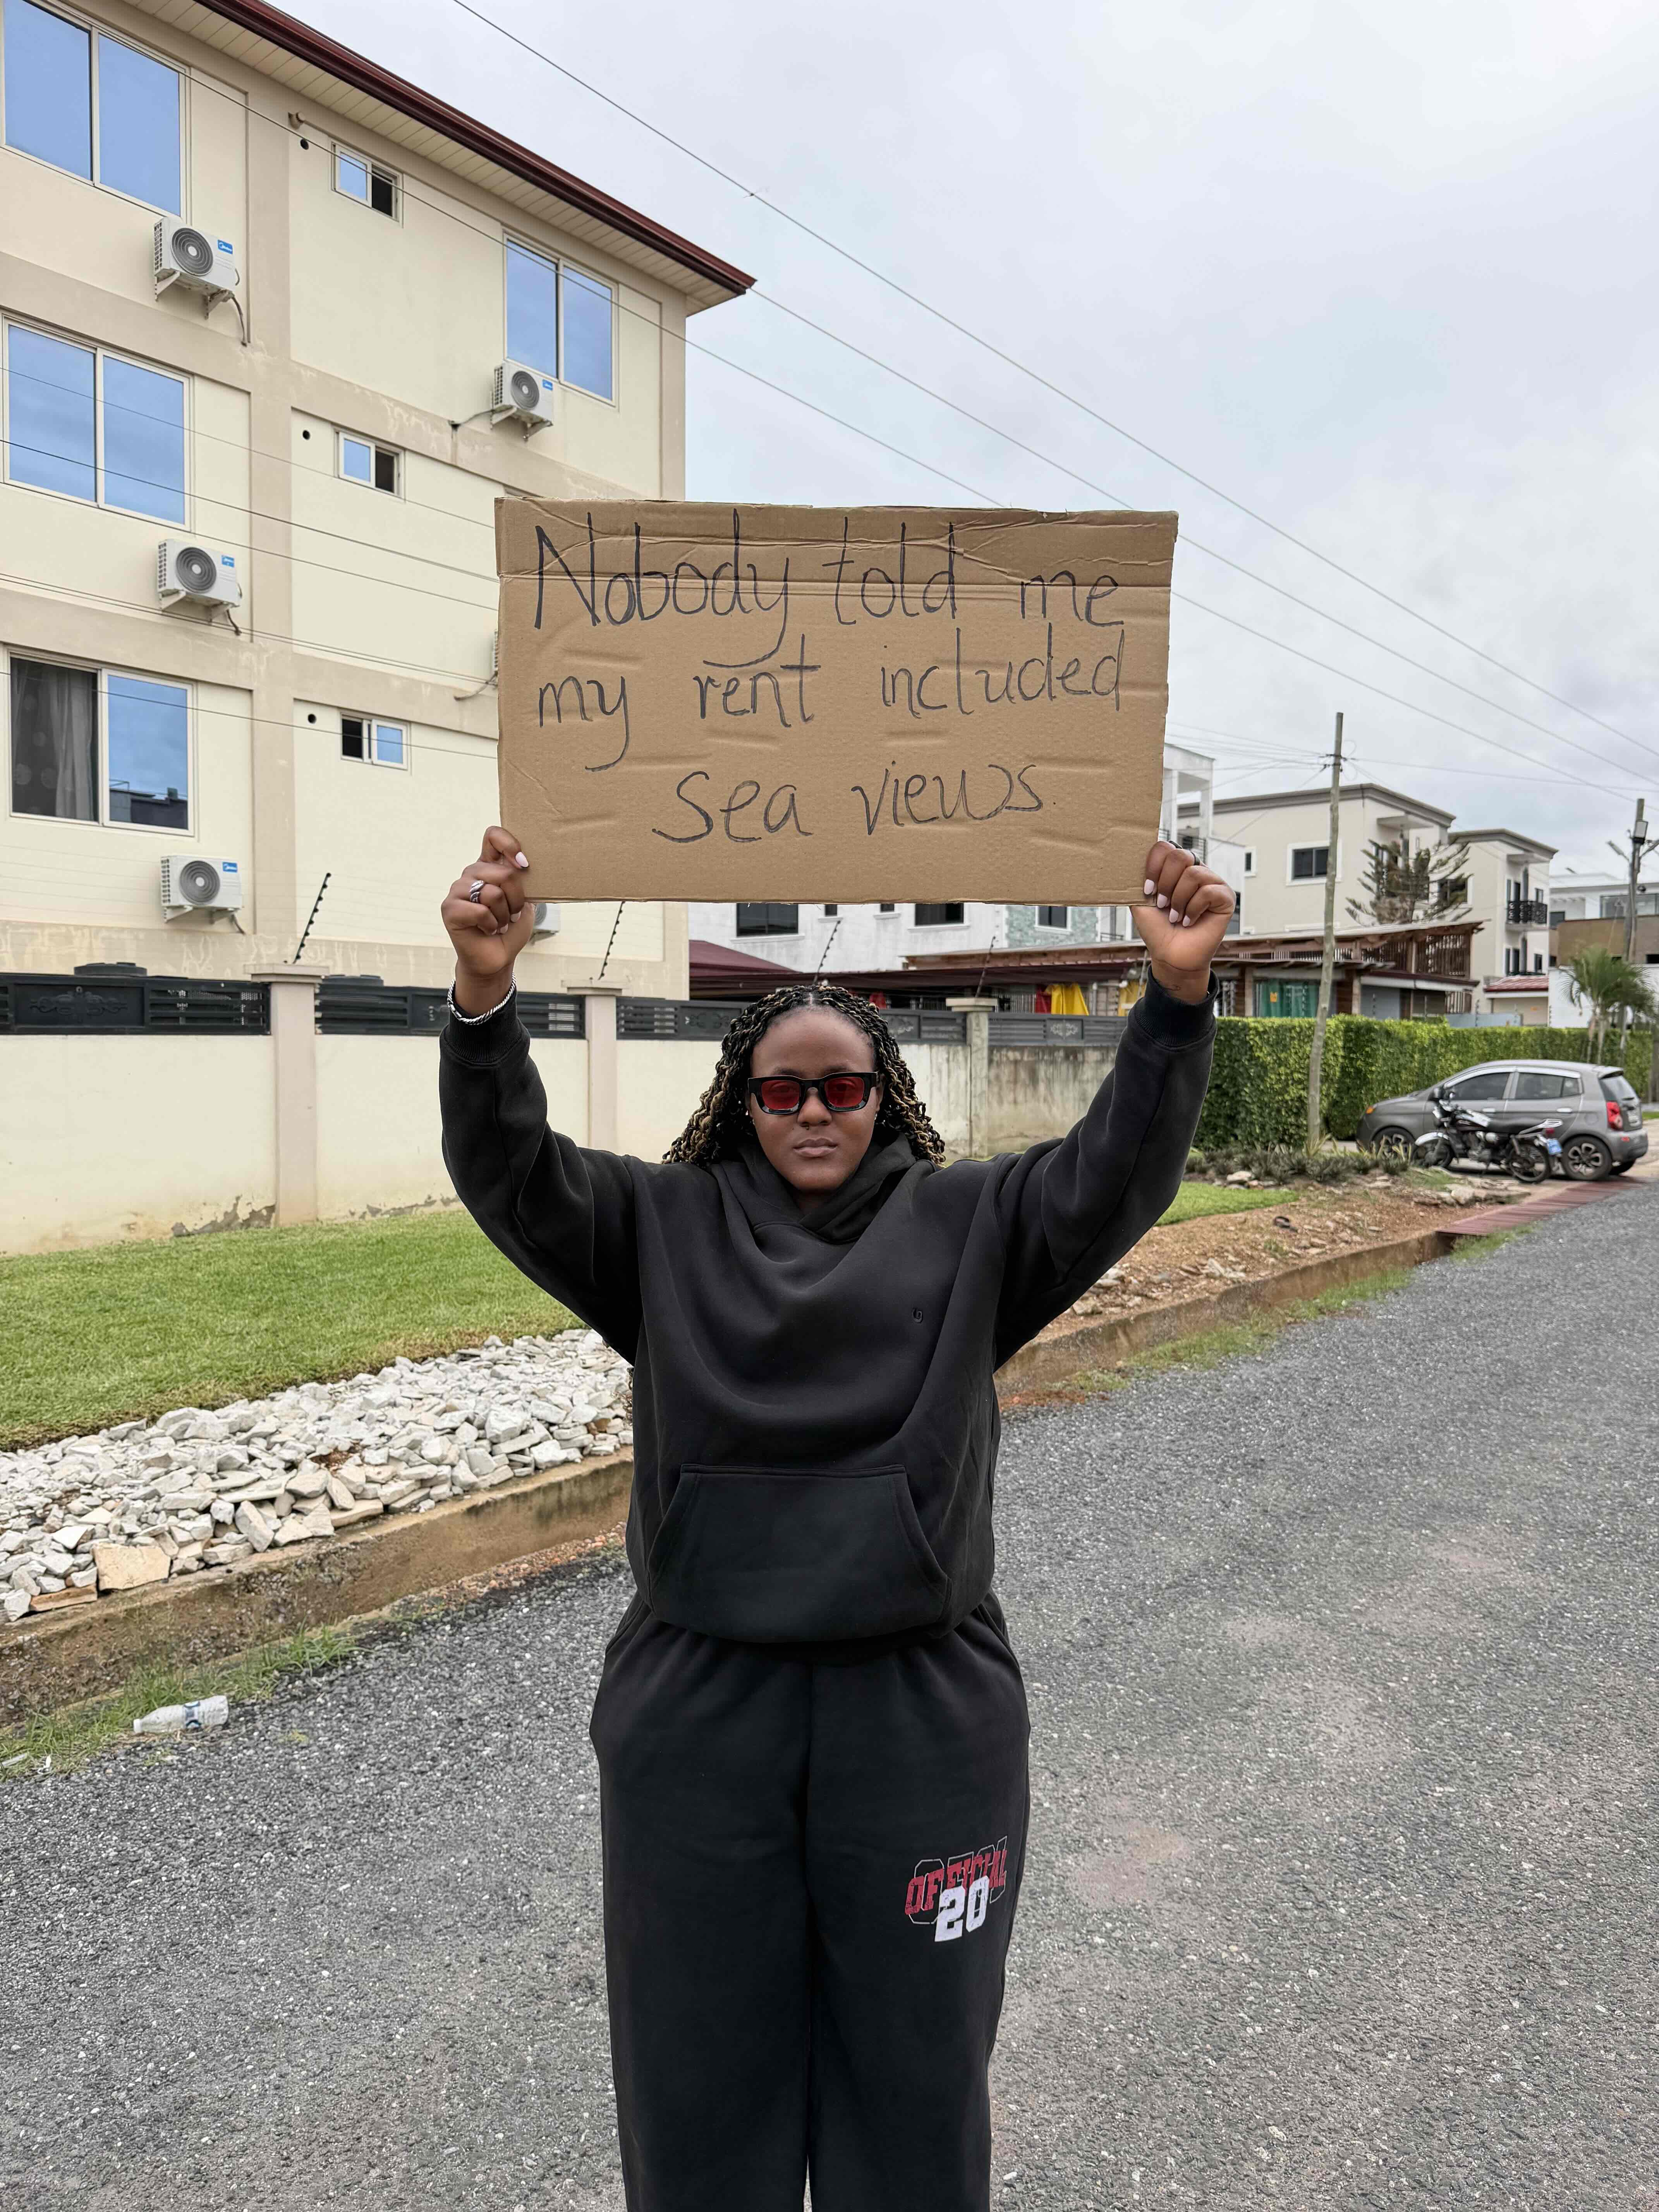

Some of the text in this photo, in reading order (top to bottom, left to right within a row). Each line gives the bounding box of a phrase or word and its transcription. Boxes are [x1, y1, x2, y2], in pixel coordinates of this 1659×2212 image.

[535, 508, 1125, 668] Nobody told me
[539, 623, 1124, 772] my rent included
[934, 1875, 989, 1942] 20
